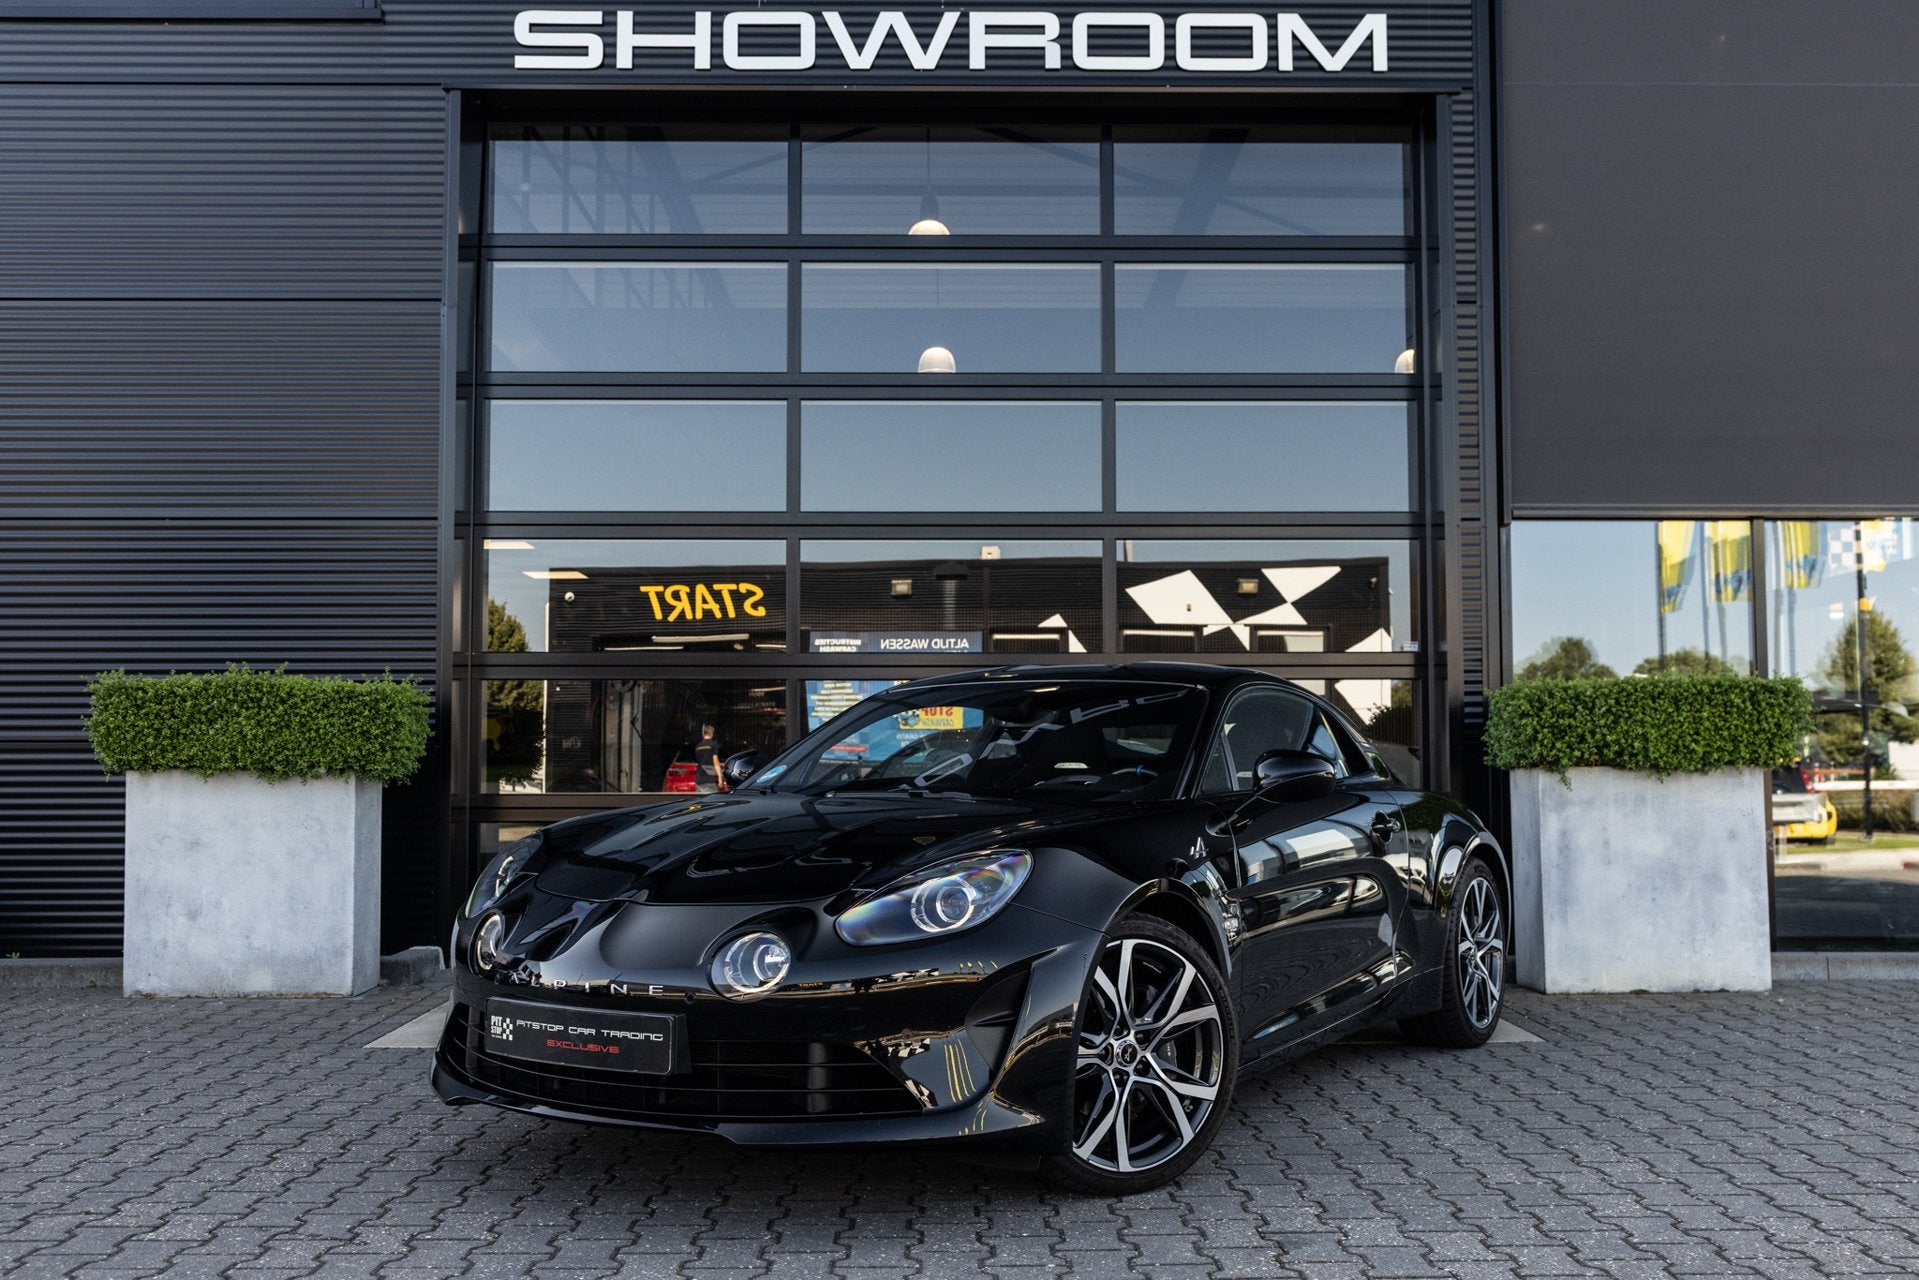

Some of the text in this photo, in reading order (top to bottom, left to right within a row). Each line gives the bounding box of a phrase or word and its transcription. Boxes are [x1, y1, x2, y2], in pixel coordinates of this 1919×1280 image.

[514, 10, 1388, 71] SHOWROOM
[490, 1015, 503, 1027] PIT
[516, 1019, 564, 1032] PITSTOP
[568, 1026, 596, 1037] CAR
[490, 1025, 503, 1035] STOP
[546, 1039, 620, 1054] EXCLUSIVE
